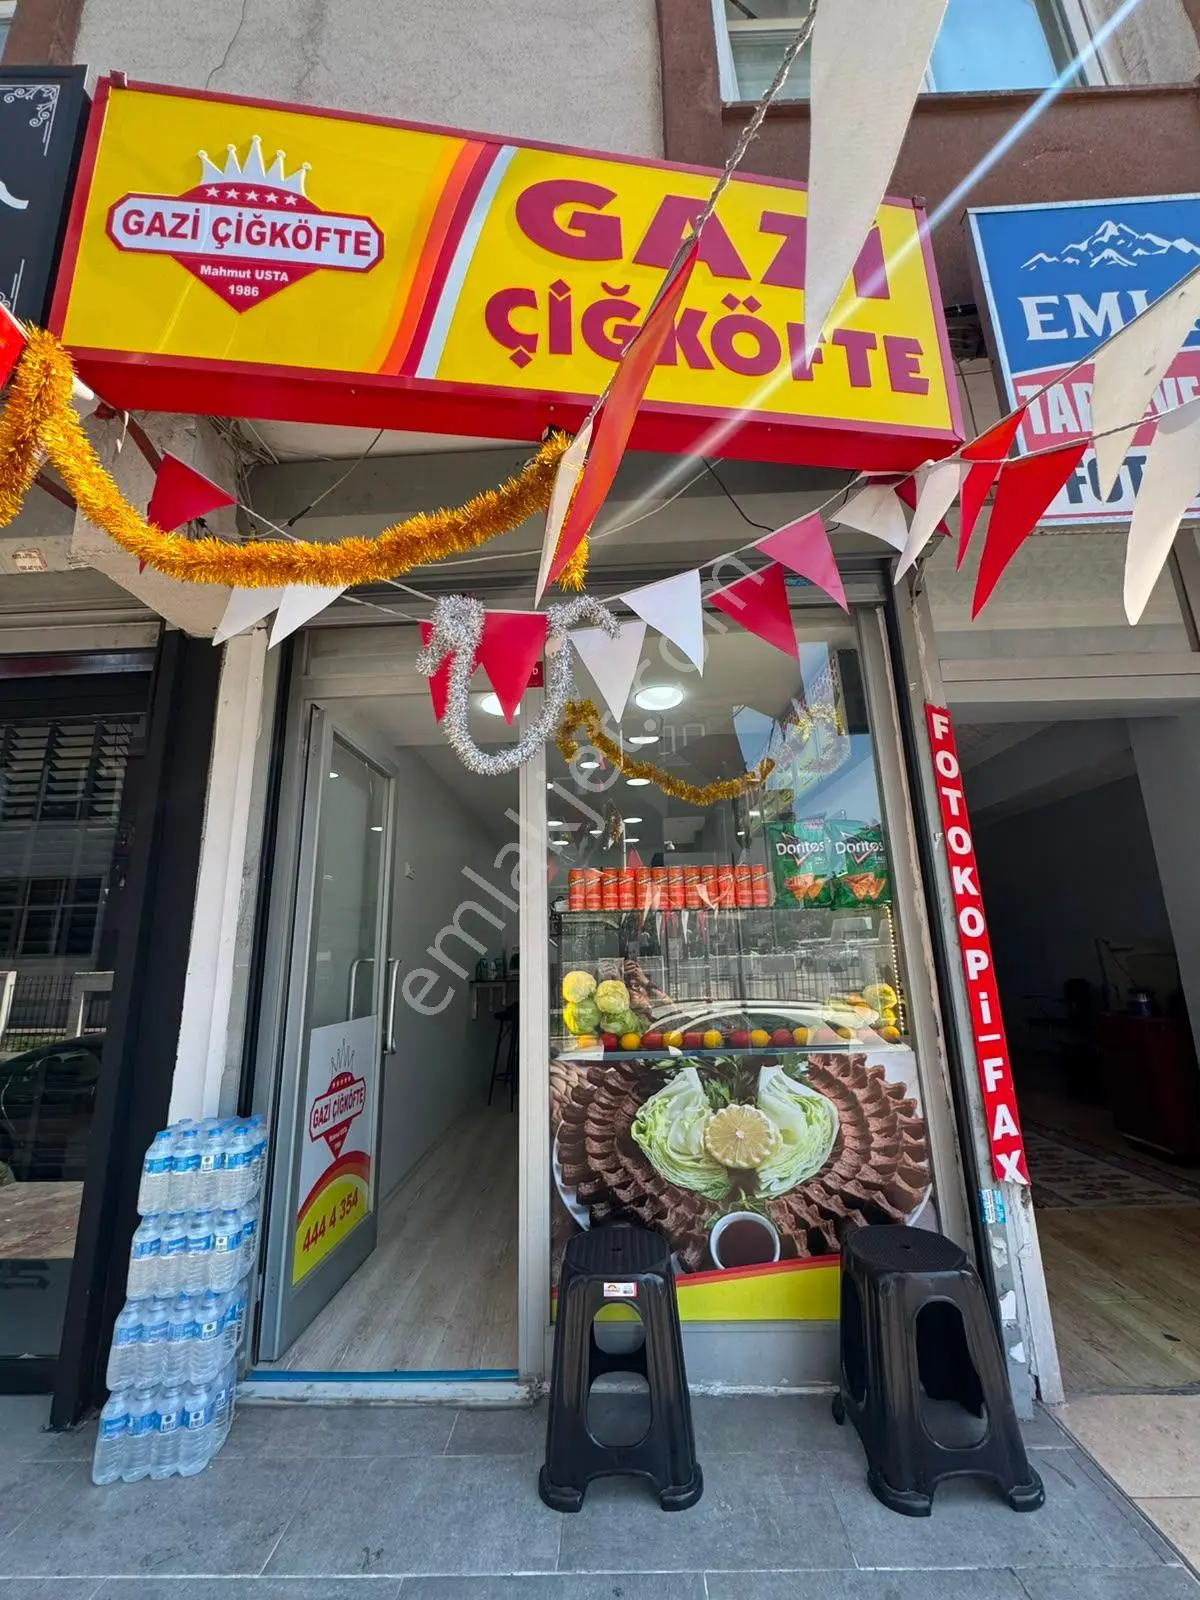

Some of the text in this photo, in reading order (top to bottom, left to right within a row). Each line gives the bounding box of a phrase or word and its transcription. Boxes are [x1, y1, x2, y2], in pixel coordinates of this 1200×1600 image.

[122, 208, 372, 258] GAZİ ÇİĞKÖFTE
[200, 264, 289, 282] Mahmut USTA
[228, 284, 260, 297] 1986
[776, 841, 825, 856] Doritos
[835, 841, 885, 855] Doritos
[302, 1186, 358, 1252] 444 4 354
